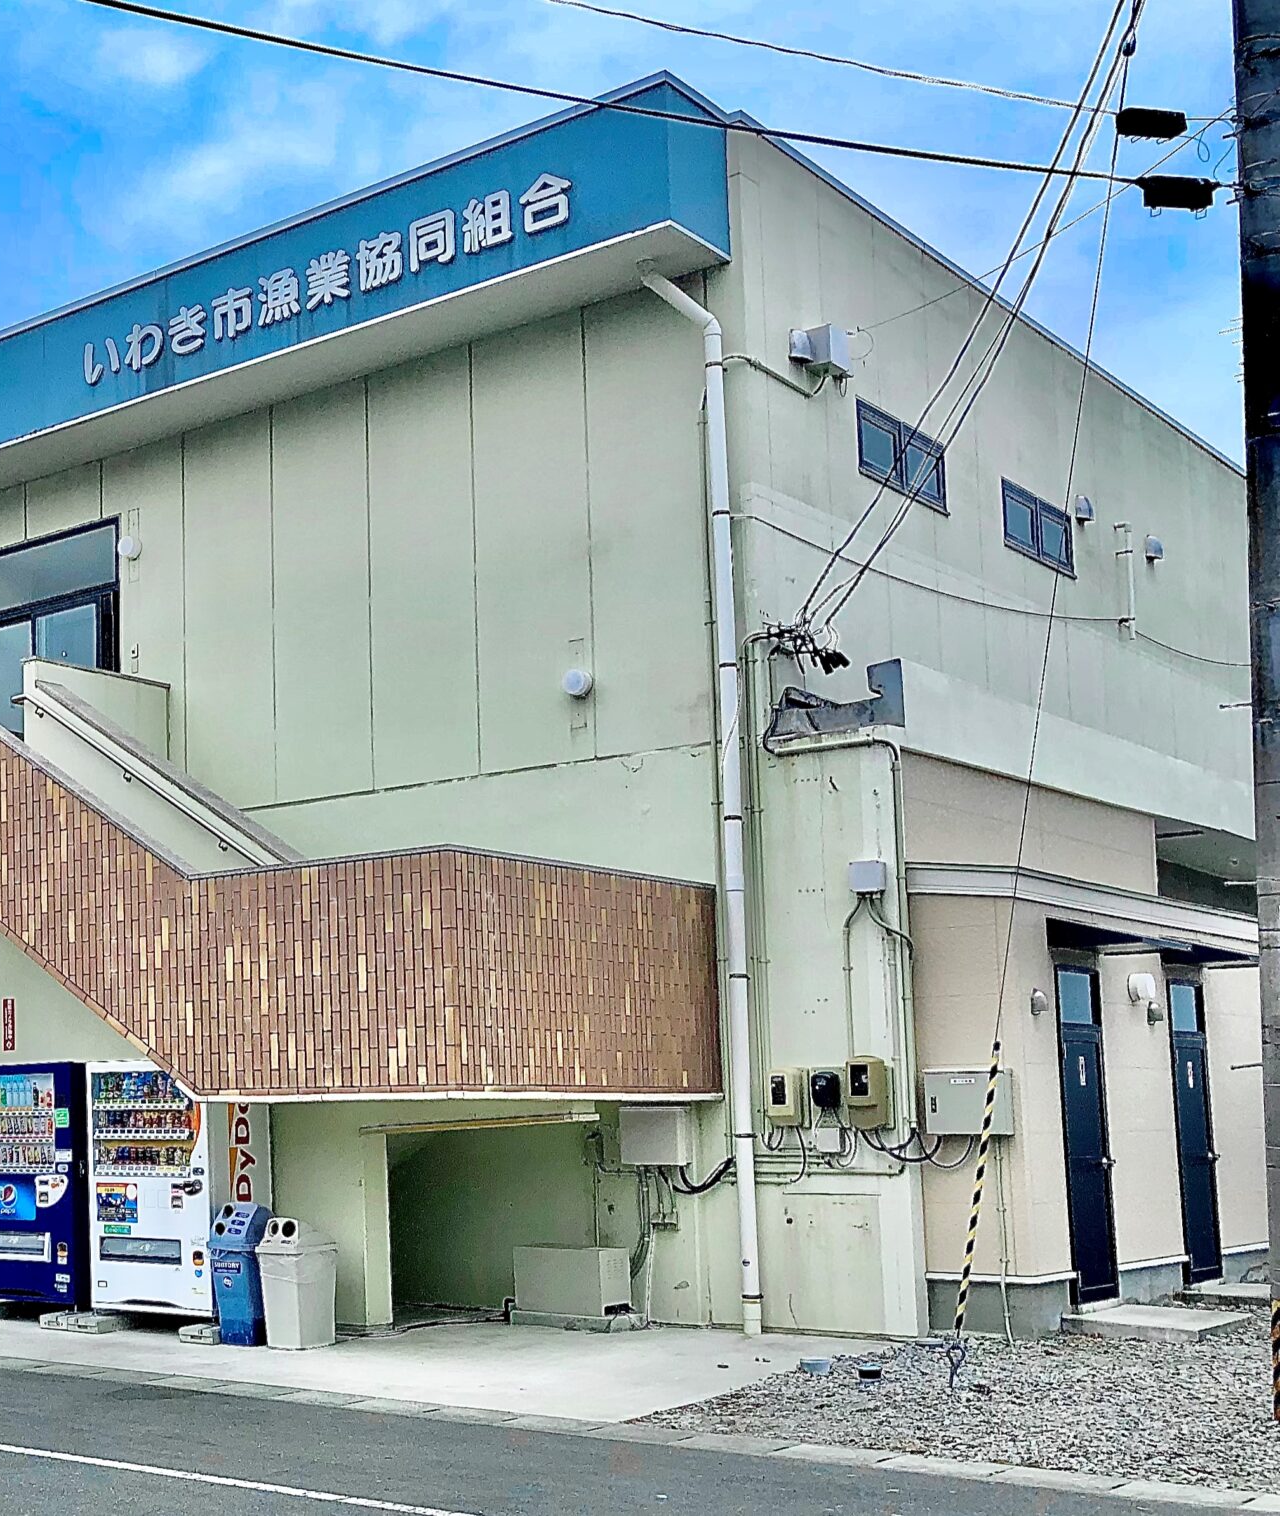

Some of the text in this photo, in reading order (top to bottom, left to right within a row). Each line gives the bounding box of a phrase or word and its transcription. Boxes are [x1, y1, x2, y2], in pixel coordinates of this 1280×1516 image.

[83, 172, 572, 386] いわき市漁業協同組合
